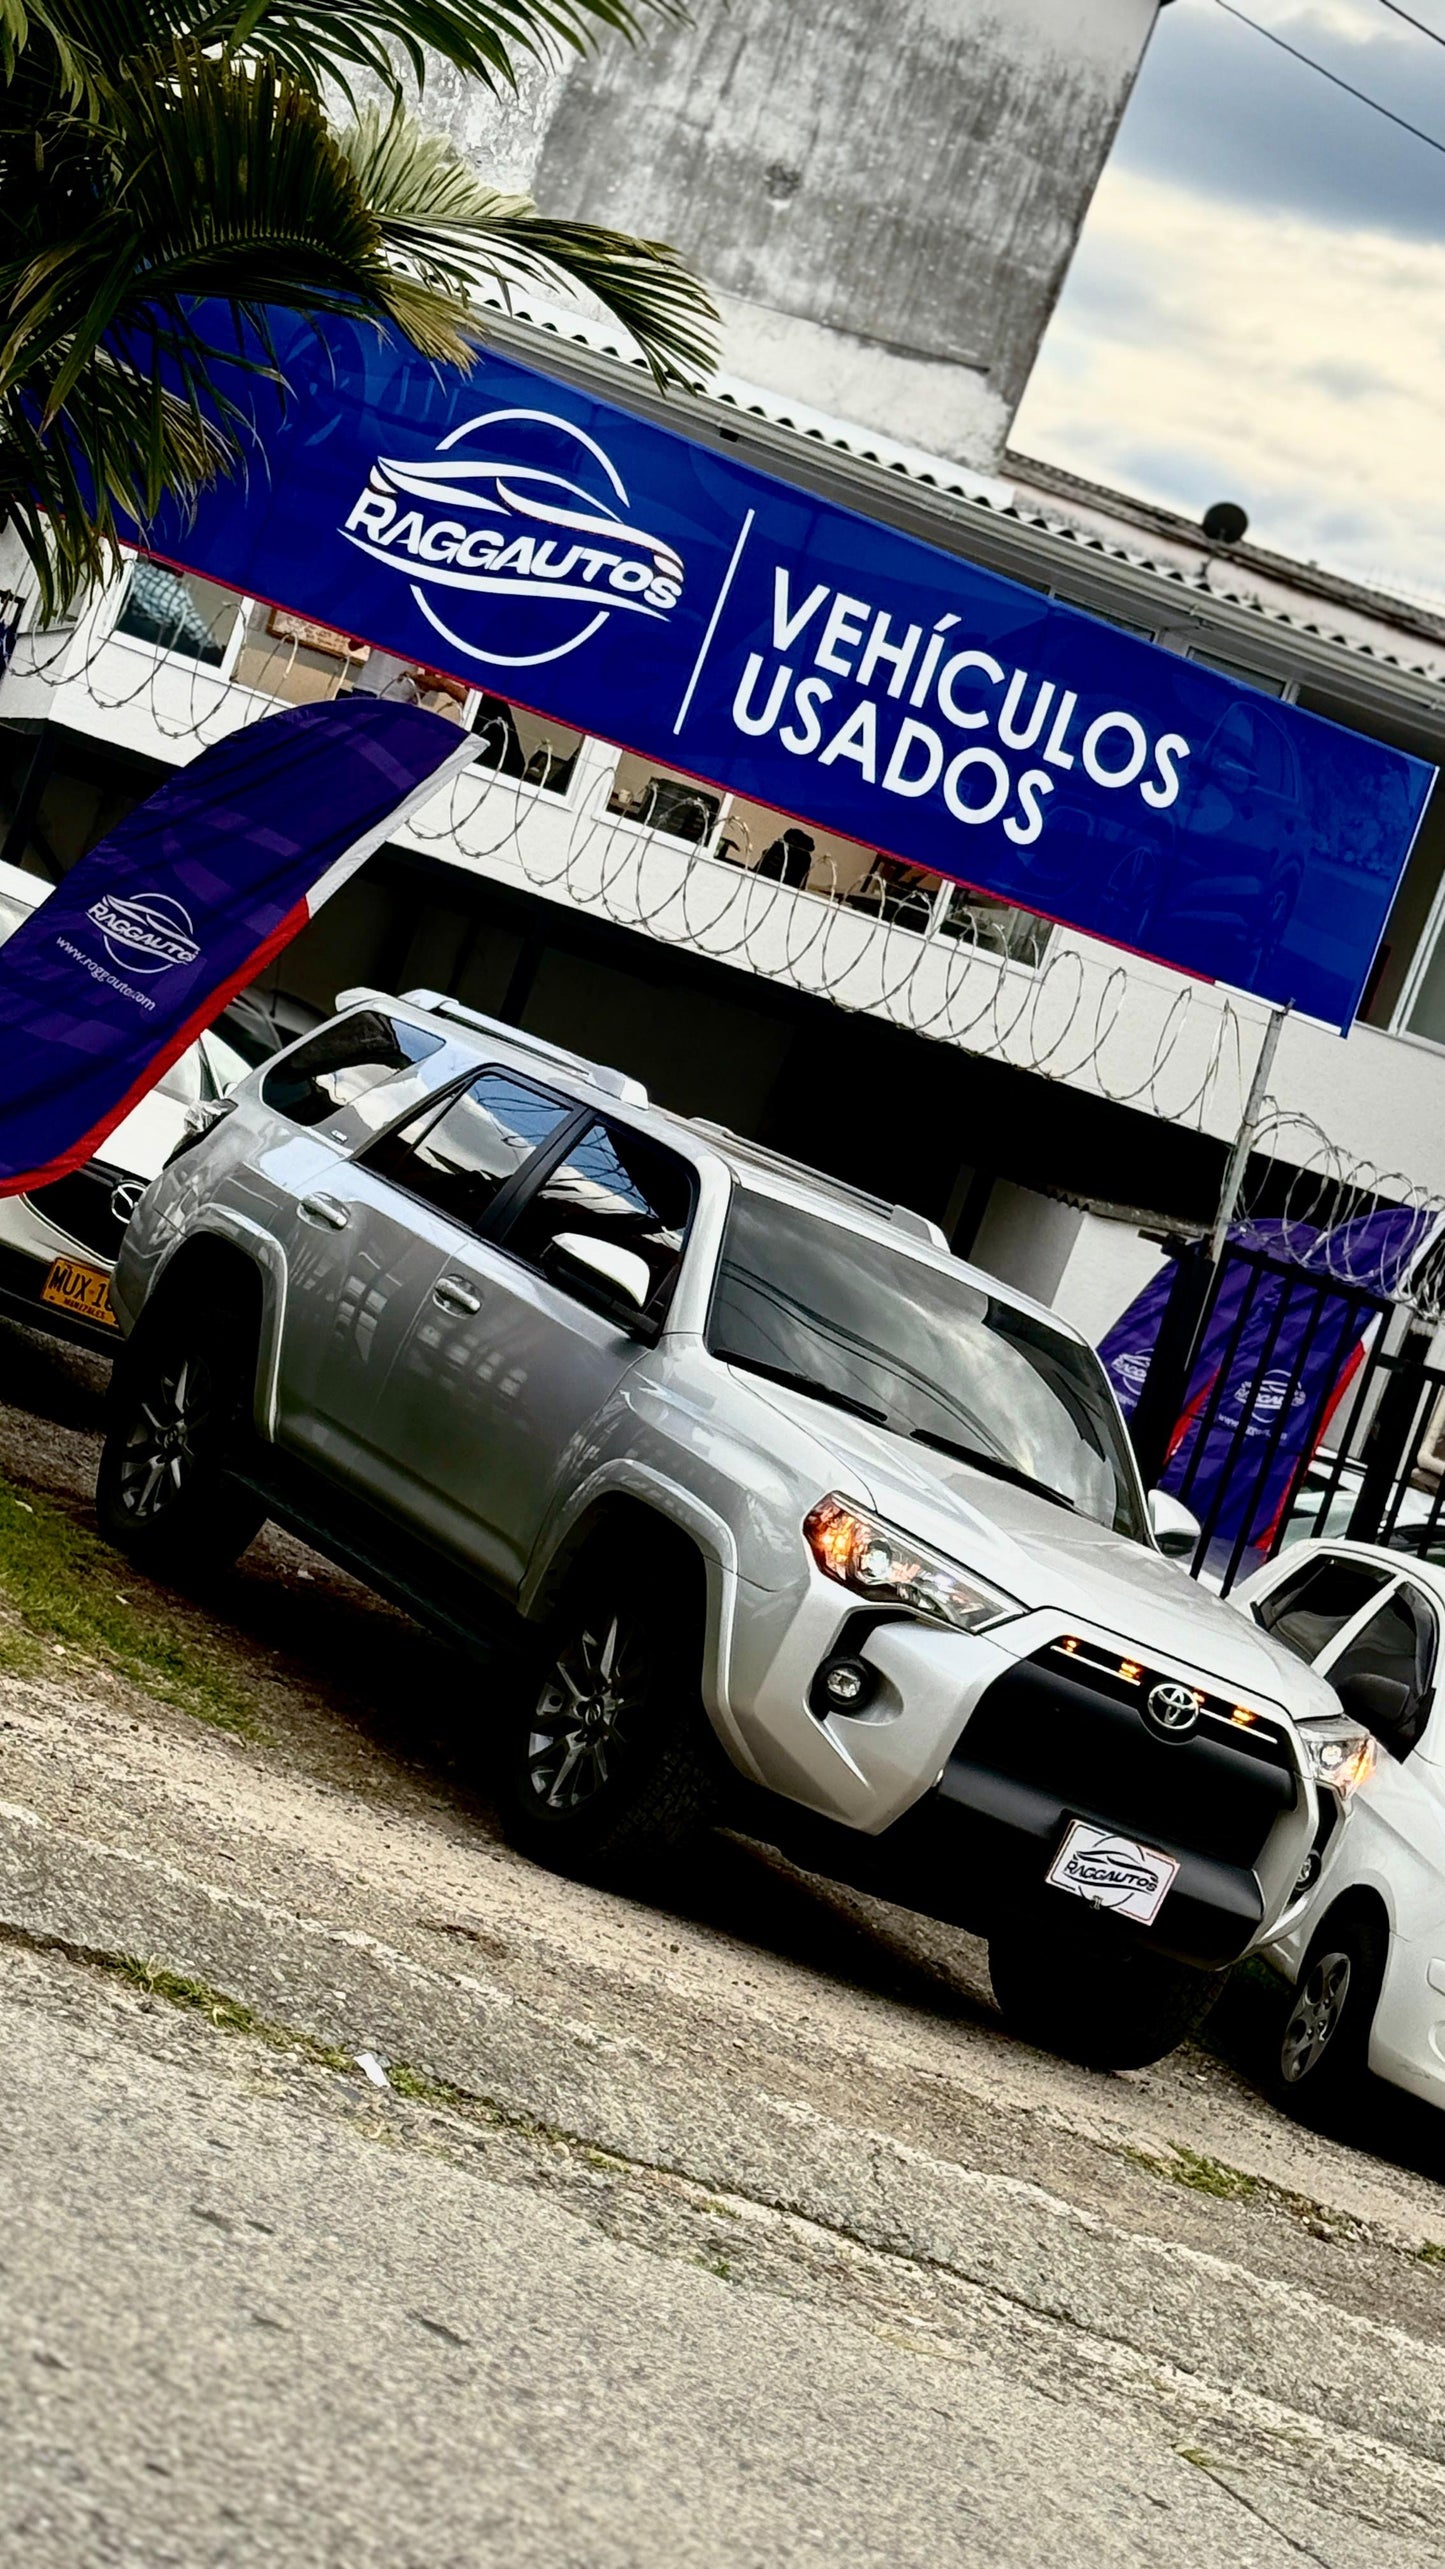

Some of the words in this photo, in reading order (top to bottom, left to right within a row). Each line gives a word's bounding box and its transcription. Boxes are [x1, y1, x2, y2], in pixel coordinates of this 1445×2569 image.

[344, 487, 683, 610] RAGGAUTOS
[732, 652, 1055, 847] USADOS
[773, 567, 1191, 811] VEHÍCULOS
[1064, 1860, 1158, 1893] RAGGAUTOS
